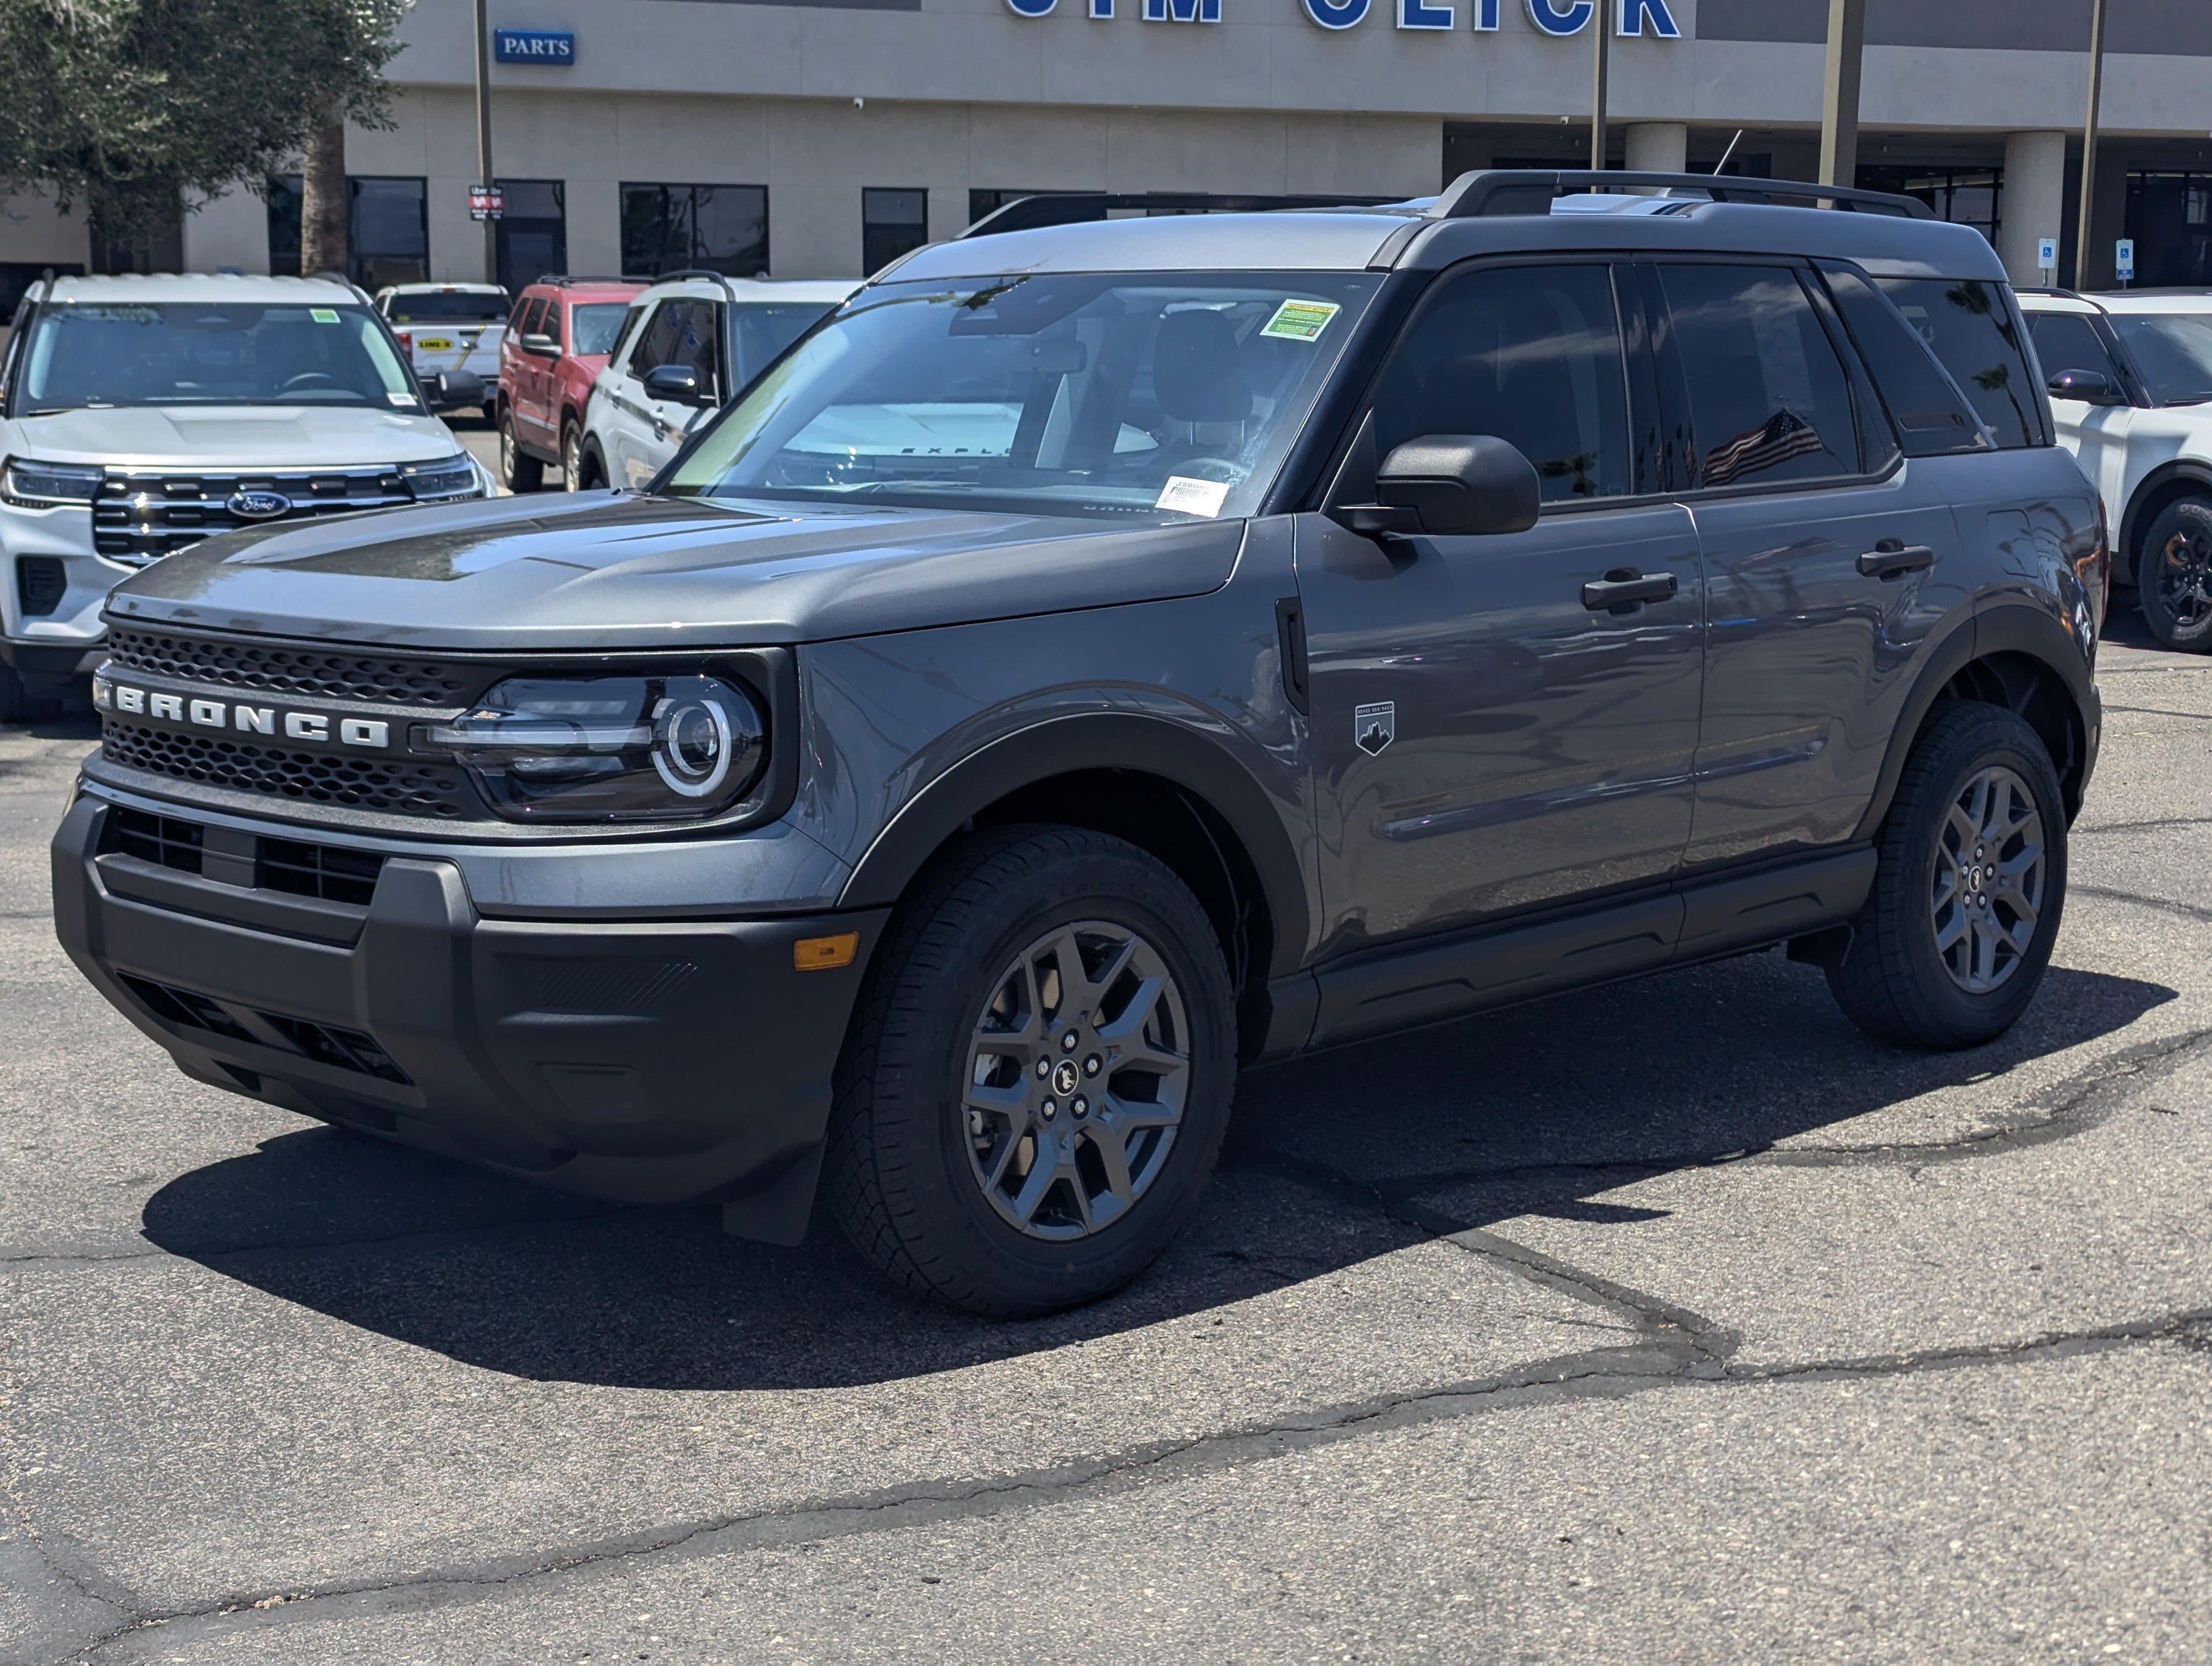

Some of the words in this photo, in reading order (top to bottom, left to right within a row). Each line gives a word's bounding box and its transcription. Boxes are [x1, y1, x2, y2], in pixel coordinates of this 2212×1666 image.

[504, 38, 569, 55] PARTS
[242, 496, 276, 510] Ford
[117, 685, 388, 748] BRONCO
